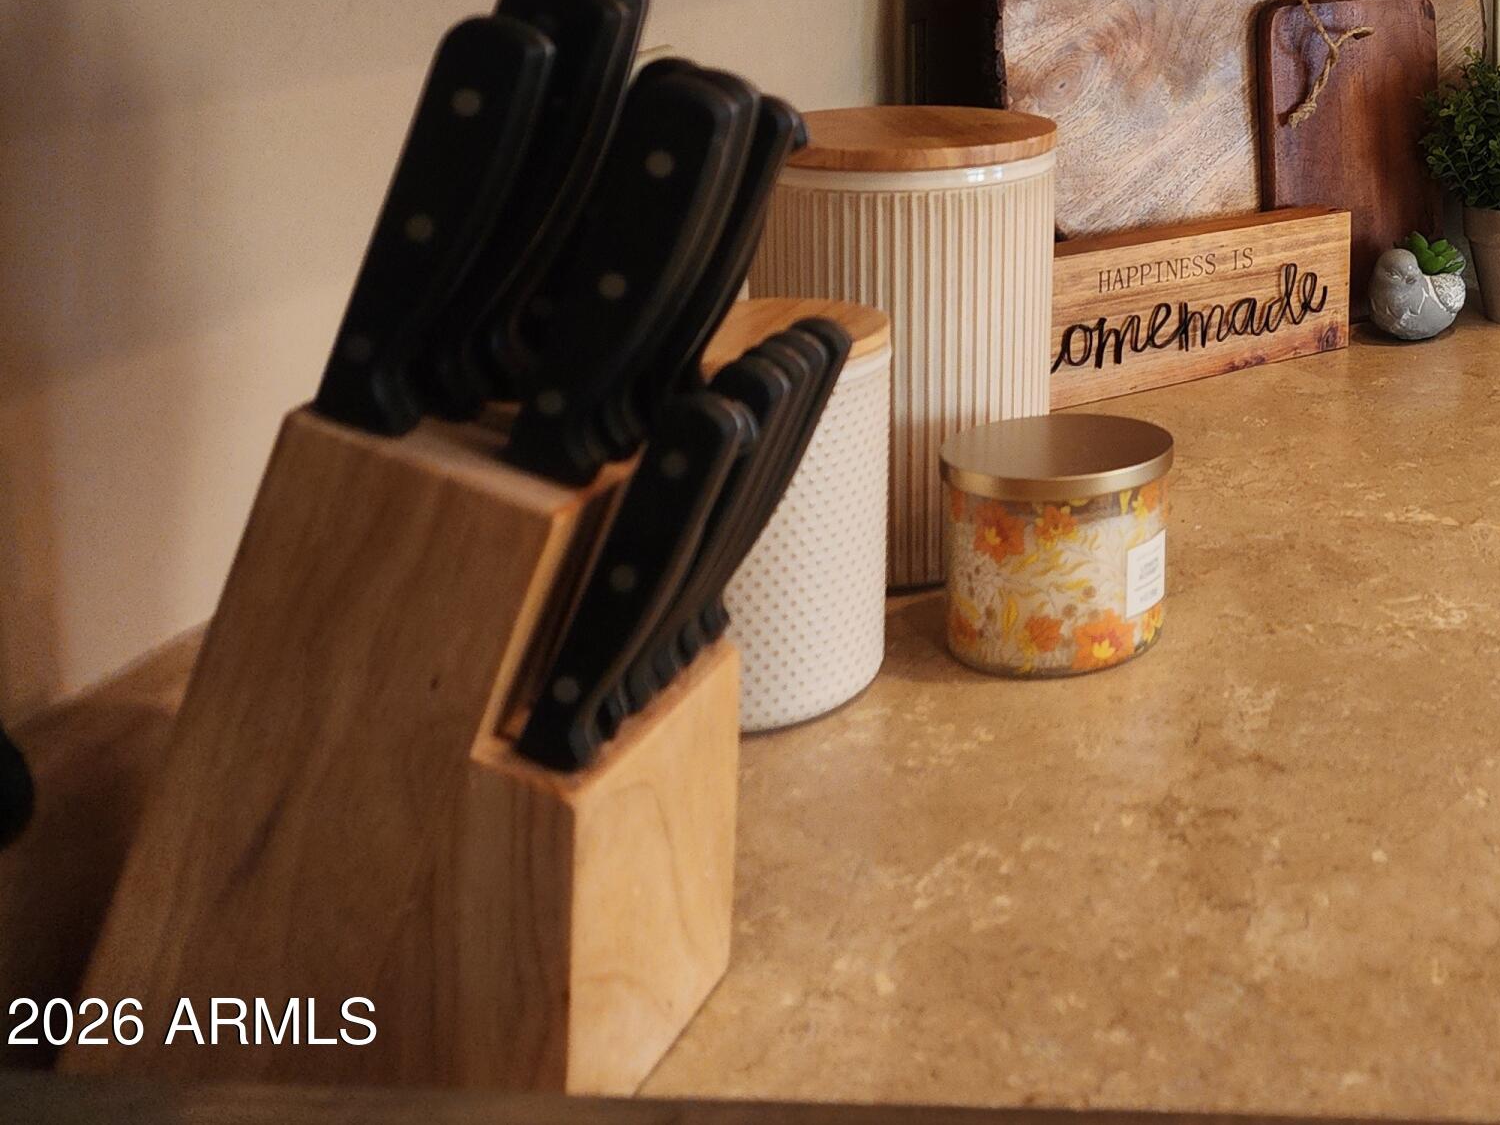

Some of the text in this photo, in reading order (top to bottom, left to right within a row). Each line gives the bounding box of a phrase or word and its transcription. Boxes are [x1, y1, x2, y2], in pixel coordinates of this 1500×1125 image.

[1098, 247, 1254, 293] HAPPINESS IS
[1051, 263, 1328, 373] omemade
